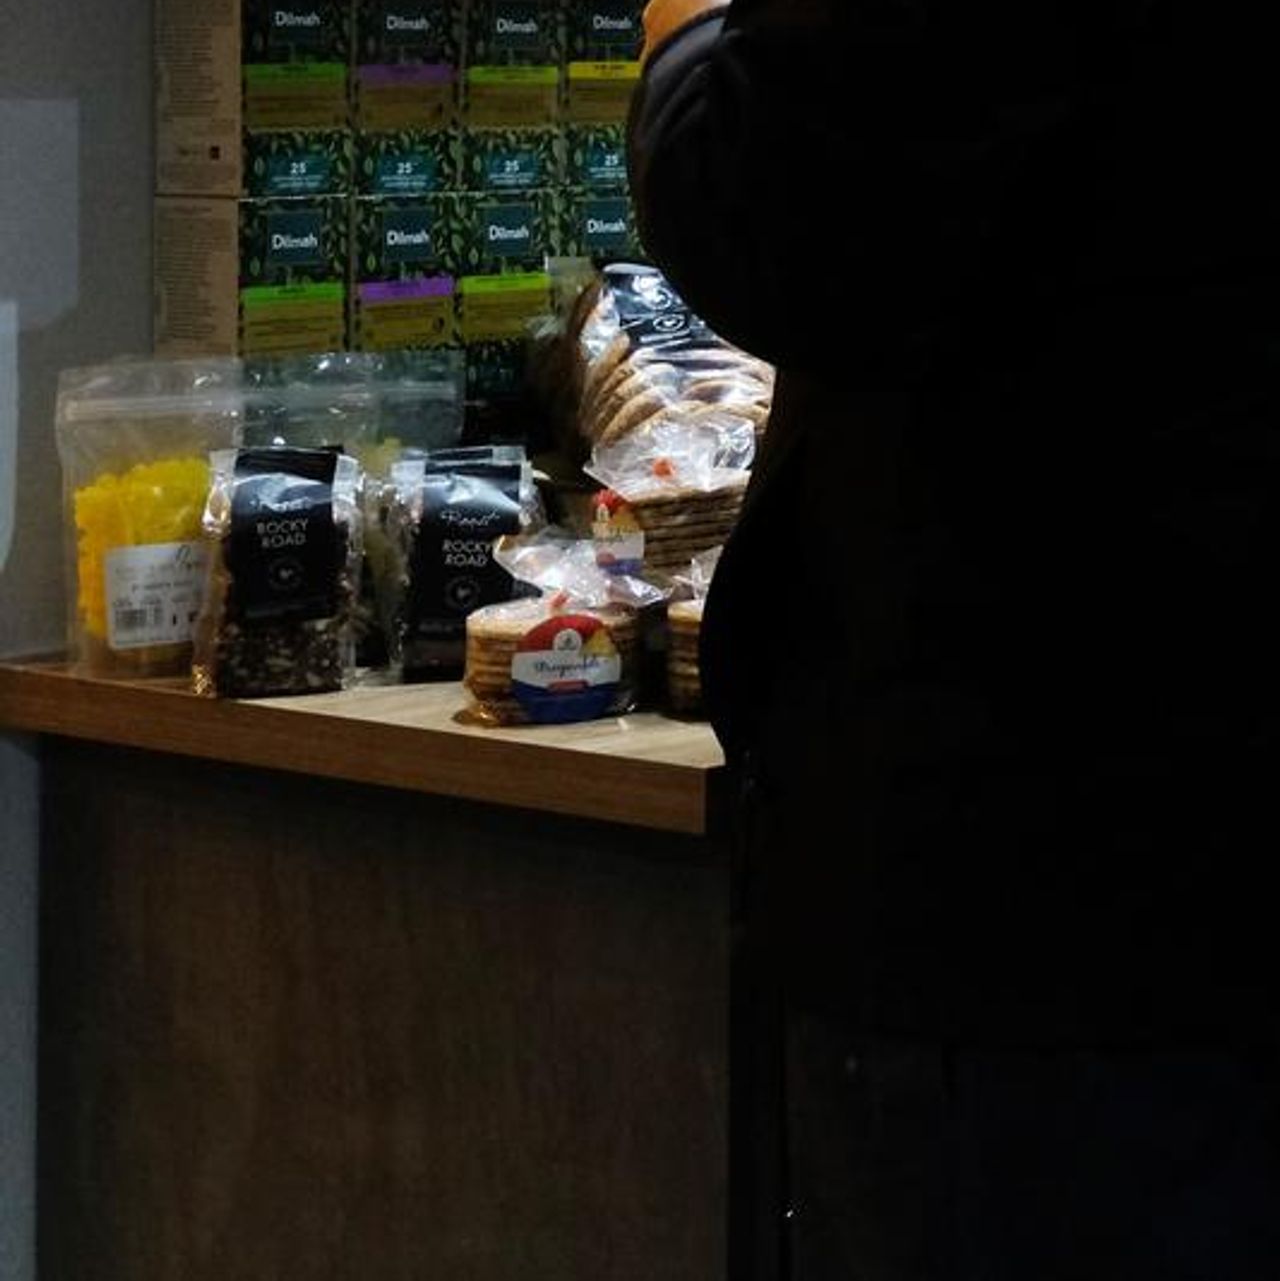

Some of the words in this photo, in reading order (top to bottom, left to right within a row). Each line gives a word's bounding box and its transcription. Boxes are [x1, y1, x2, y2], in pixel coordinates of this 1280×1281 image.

[273, 10, 321, 28] Dilmah
[385, 15, 429, 32] Dilmah
[496, 18, 538, 35] Dilmah
[592, 14, 634, 31] Dilmah
[488, 225, 530, 243] Dilmah
[586, 218, 627, 236] Dilmah
[271, 232, 319, 251] Dilmah
[386, 229, 430, 247] Dilmah
[256, 517, 309, 536] ROCKY
[260, 533, 306, 549] ROAD
[444, 552, 488, 568] ROAD
